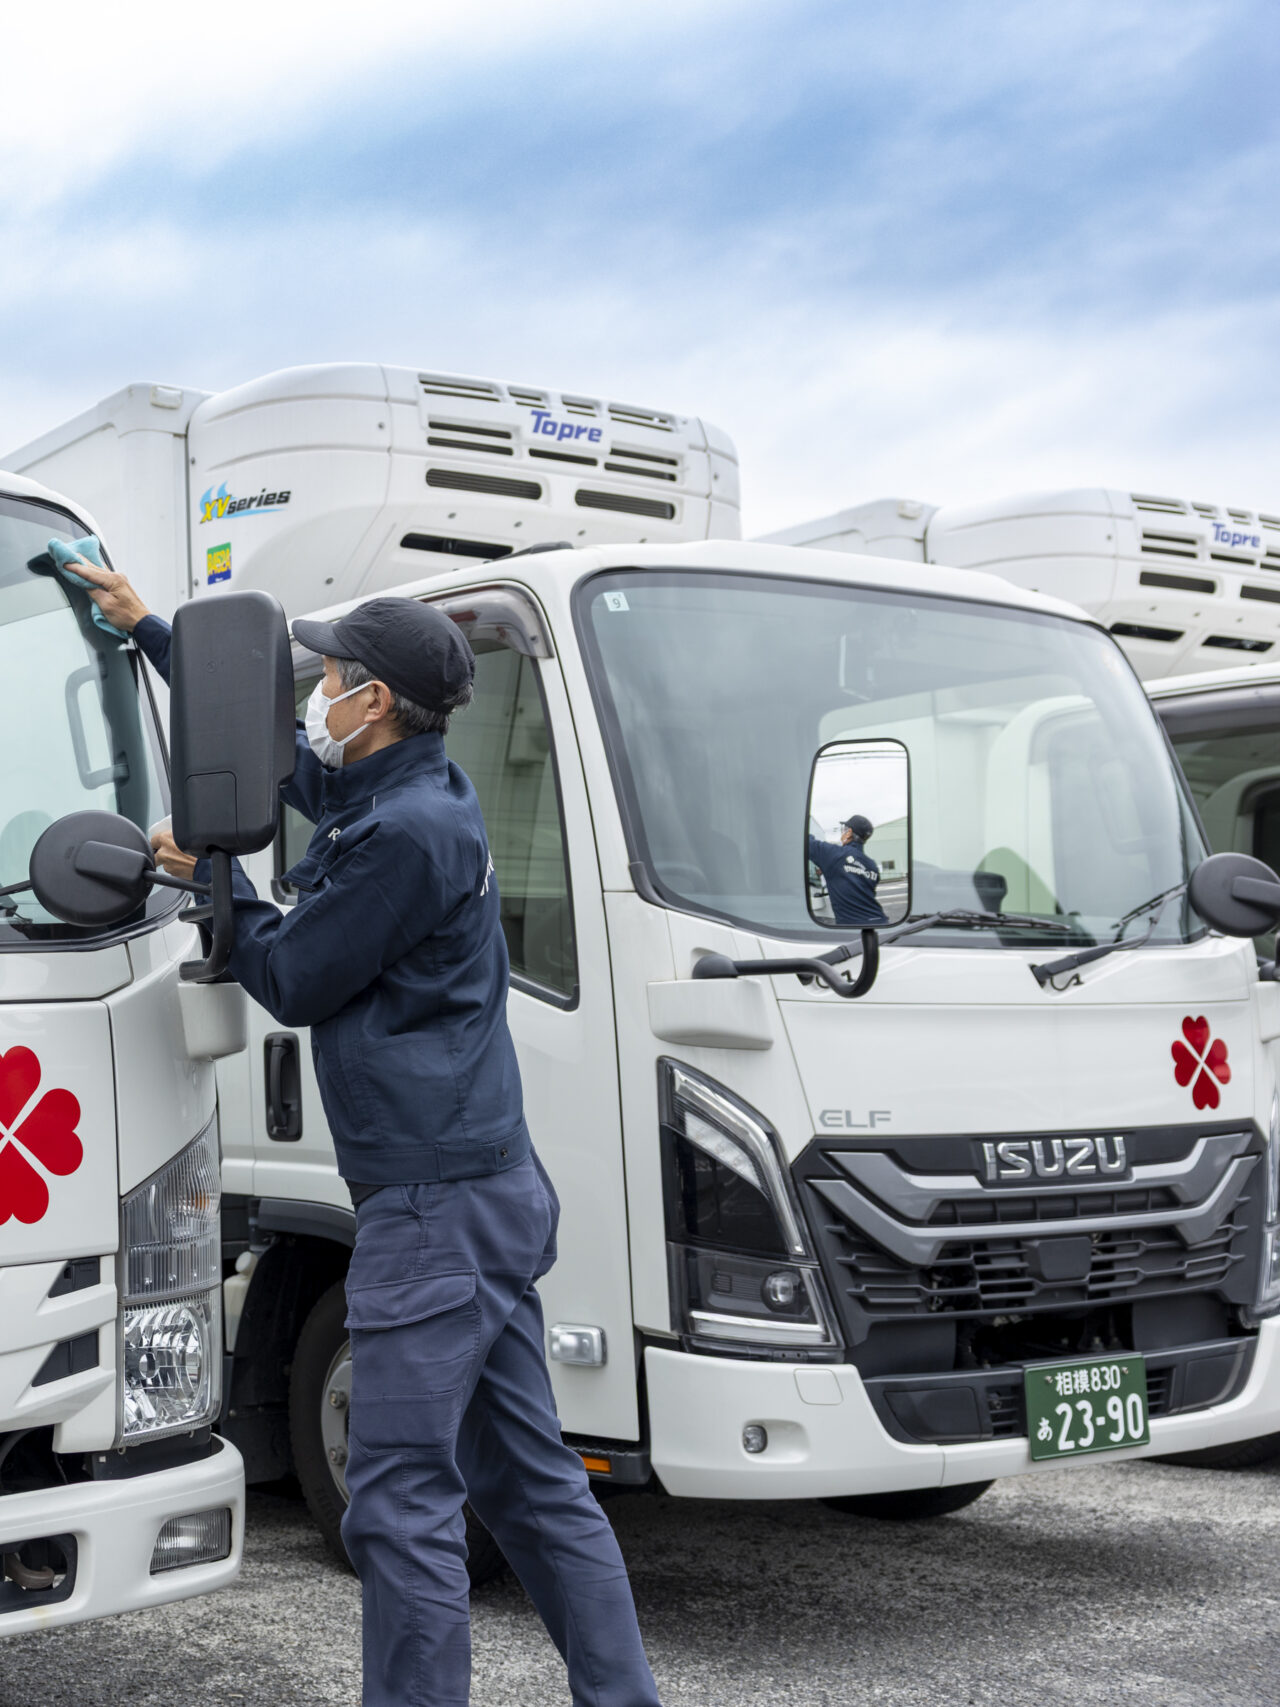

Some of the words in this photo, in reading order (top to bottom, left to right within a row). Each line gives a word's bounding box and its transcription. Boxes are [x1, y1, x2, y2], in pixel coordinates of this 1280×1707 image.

[531, 410, 602, 443] Topre
[1212, 522, 1260, 548] Topre
[819, 1110, 891, 1128] ELF
[983, 1136, 1126, 1181] ISUZU
[1037, 1416, 1053, 1442] あ
[1055, 1393, 1144, 1451] 23-90
